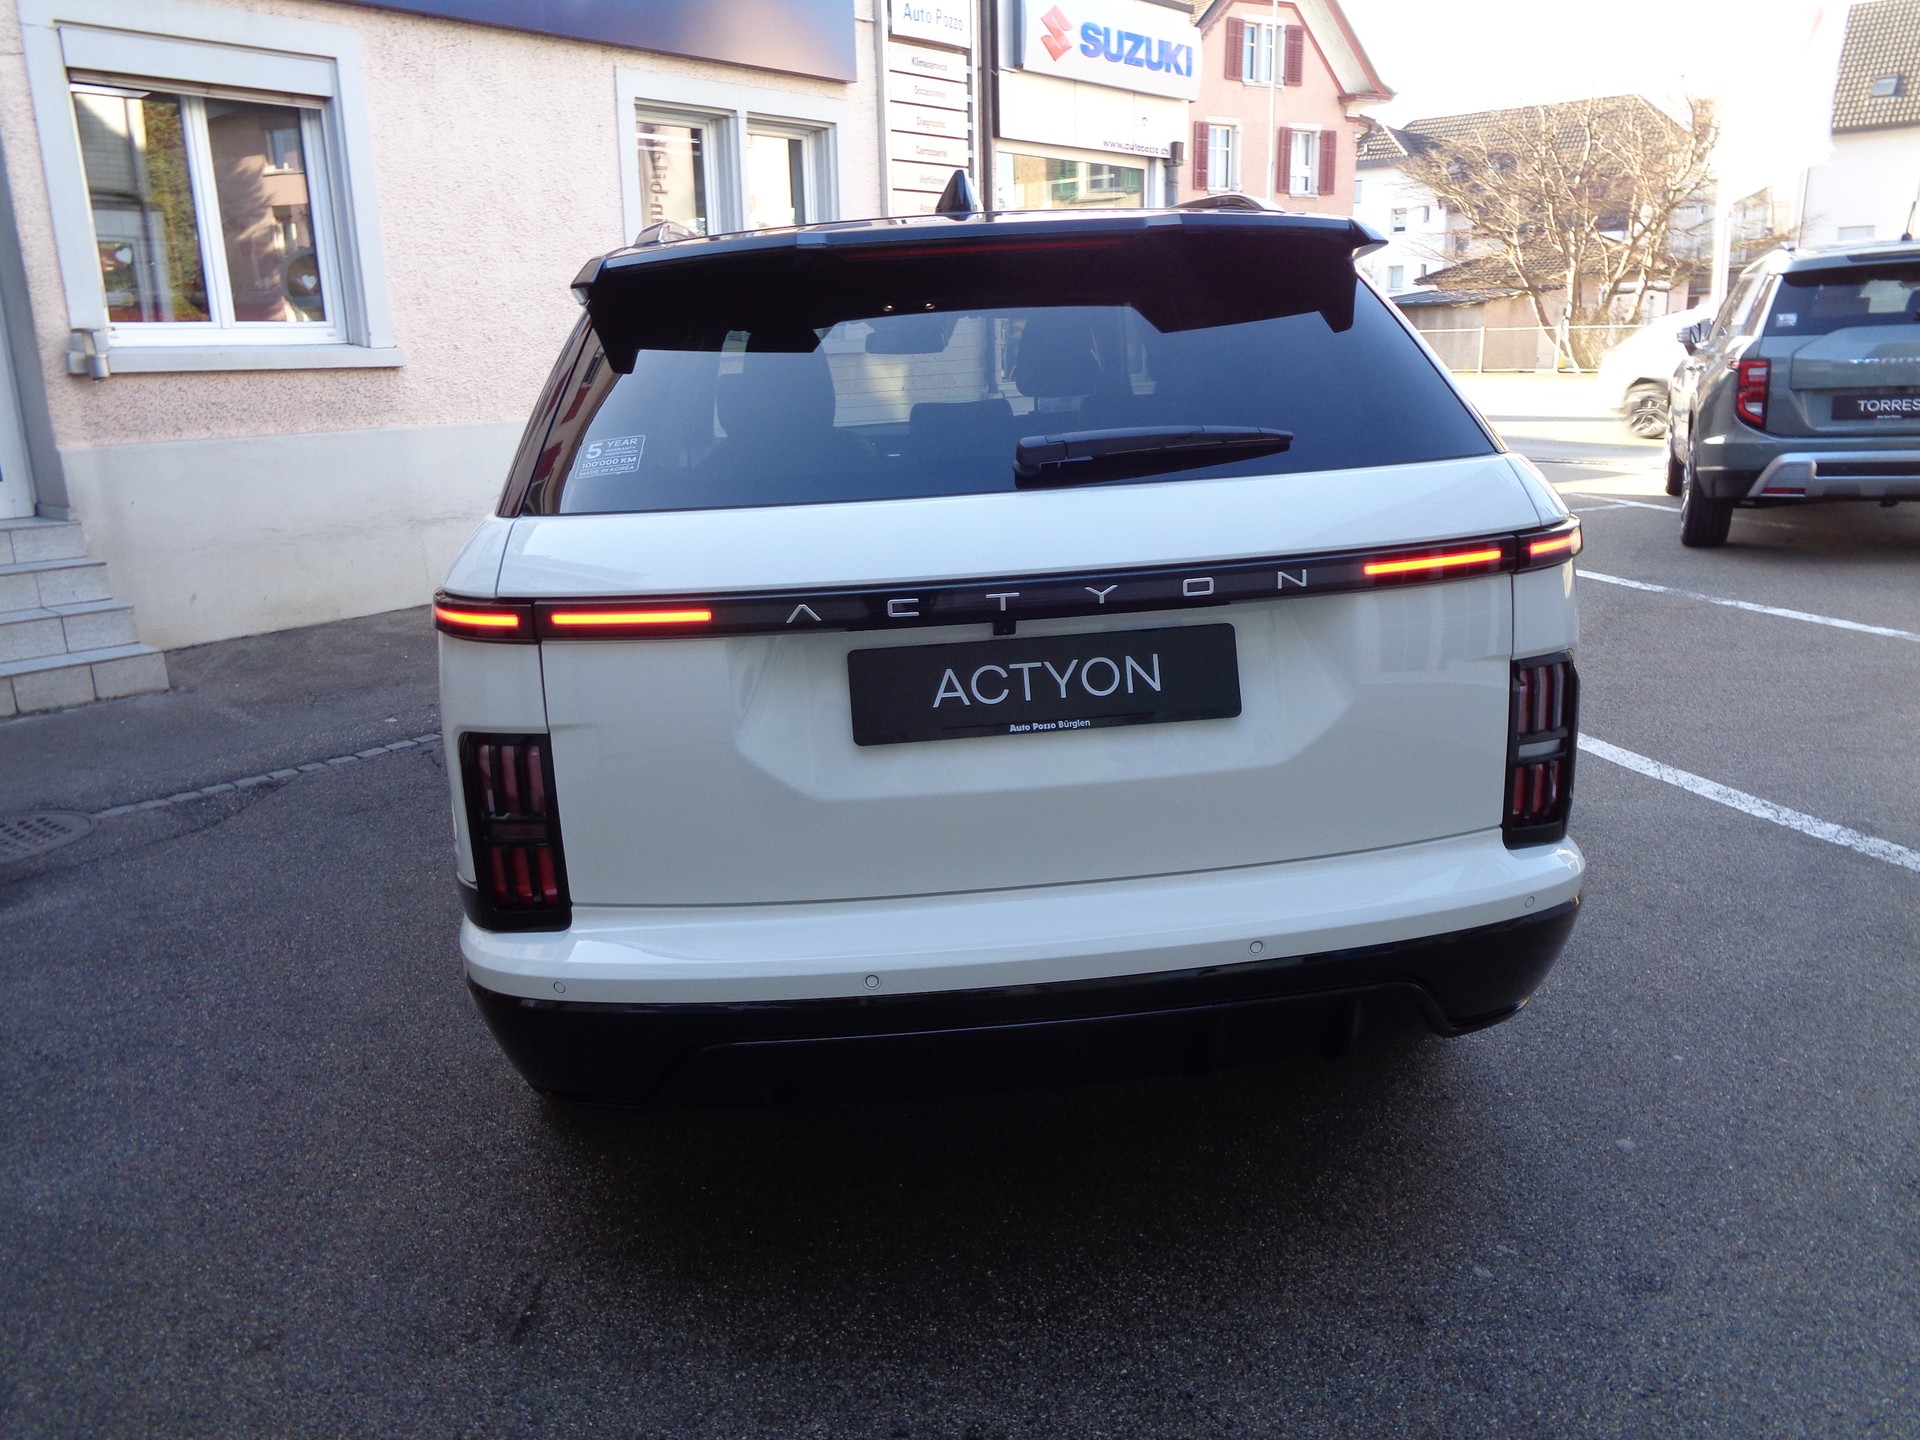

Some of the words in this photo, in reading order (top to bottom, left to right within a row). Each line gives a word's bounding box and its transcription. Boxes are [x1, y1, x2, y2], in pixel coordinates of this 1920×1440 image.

[903, 2, 932, 24] Auto
[935, 8, 963, 31] Pozzo
[1079, 21, 1193, 78] SUZUKI
[1857, 399, 1920, 412] TORRES
[586, 442, 603, 459] 5
[607, 438, 638, 447] YEAR
[786, 569, 1307, 624] ACTYON
[933, 653, 1162, 708] ACTYON
[1009, 724, 1031, 732] Auto
[1058, 719, 1091, 728] Bürglen
